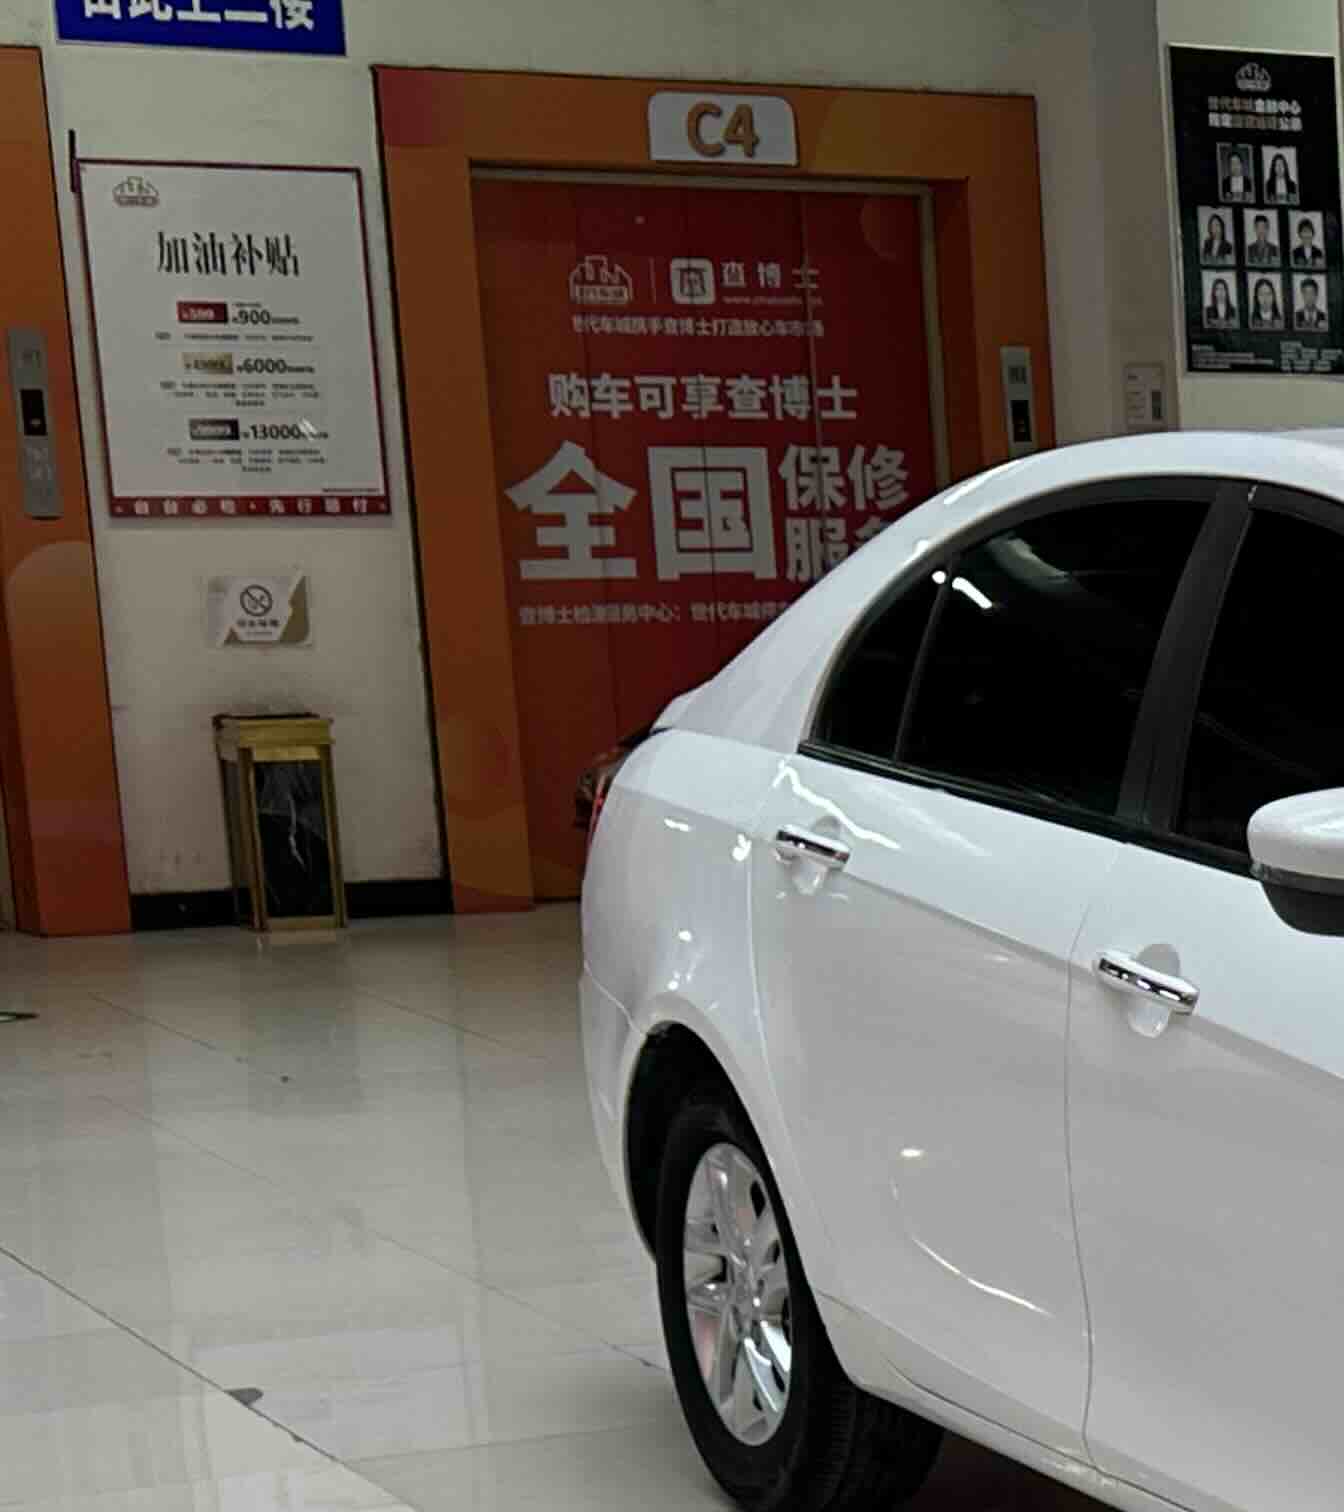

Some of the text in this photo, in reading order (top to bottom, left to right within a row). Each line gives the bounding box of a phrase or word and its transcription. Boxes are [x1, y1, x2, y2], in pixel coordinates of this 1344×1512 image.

[686, 102, 761, 158] C4
[156, 231, 300, 277] 加油补贴
[720, 261, 820, 291] 查博士
[548, 372, 858, 421] 购车可享查博士
[778, 444, 909, 511] 保修
[504, 440, 777, 582] 全国
